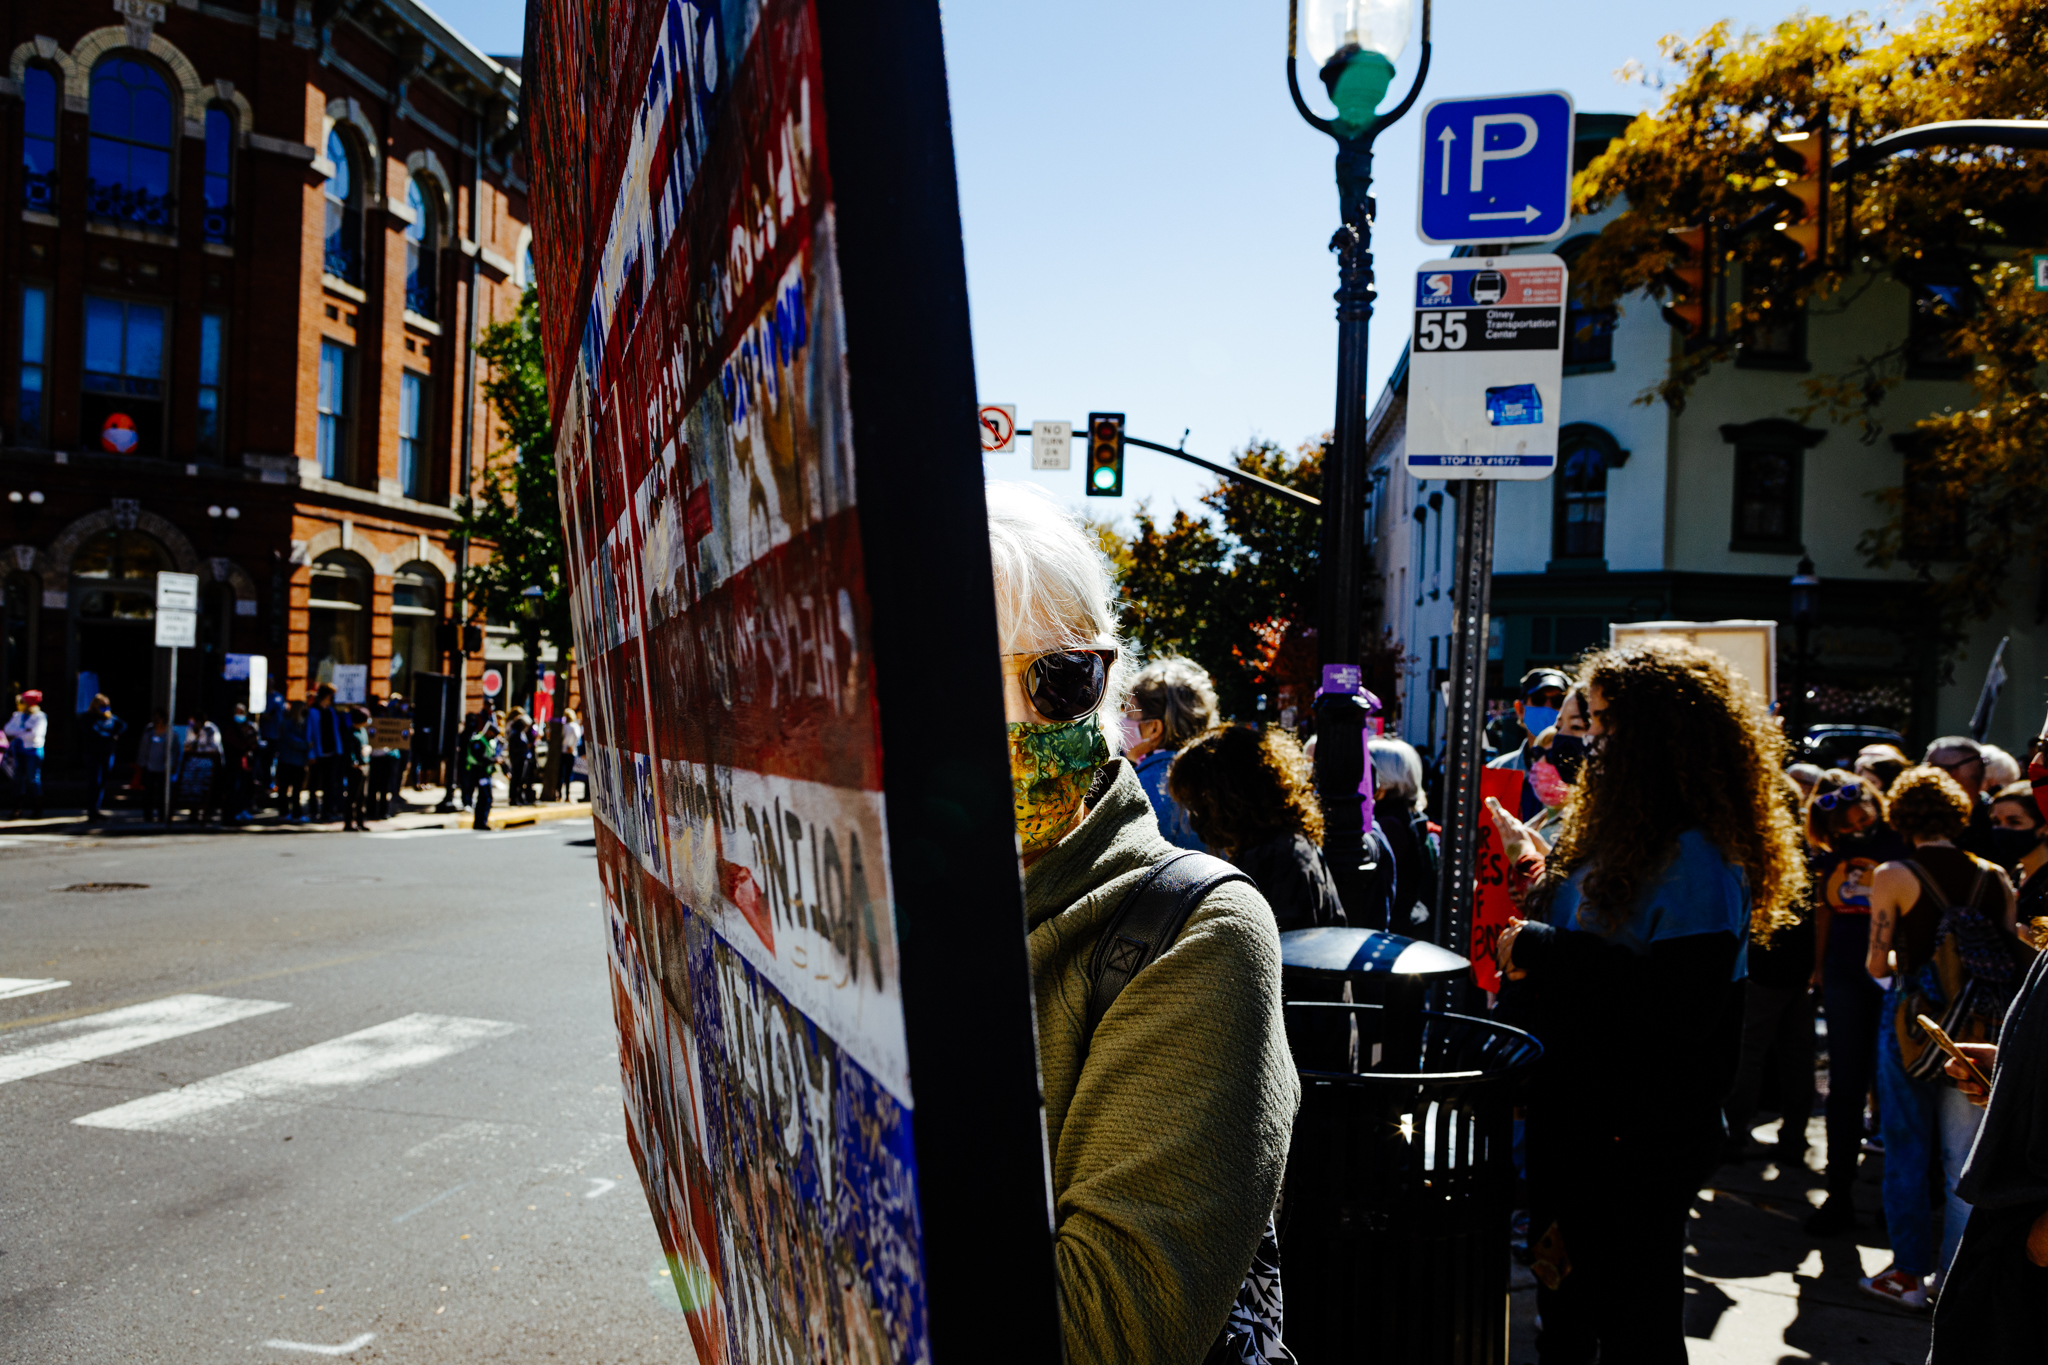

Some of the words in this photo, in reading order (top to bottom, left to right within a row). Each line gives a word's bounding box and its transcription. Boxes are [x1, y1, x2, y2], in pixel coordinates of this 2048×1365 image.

[1469, 113, 1539, 192] P
[1422, 296, 1452, 305] SEPTA
[1486, 310, 1516, 320] Olney
[1485, 319, 1557, 330] Transportation
[1419, 312, 1468, 350] 55
[1485, 329, 1518, 339] Center
[1043, 425, 1062, 434] NO
[1040, 438, 1064, 446] TURN
[1044, 448, 1059, 456] ON
[1043, 458, 1060, 466] RED
[1440, 456, 1467, 465] STOP
[717, 961, 832, 1202] AGAIN
